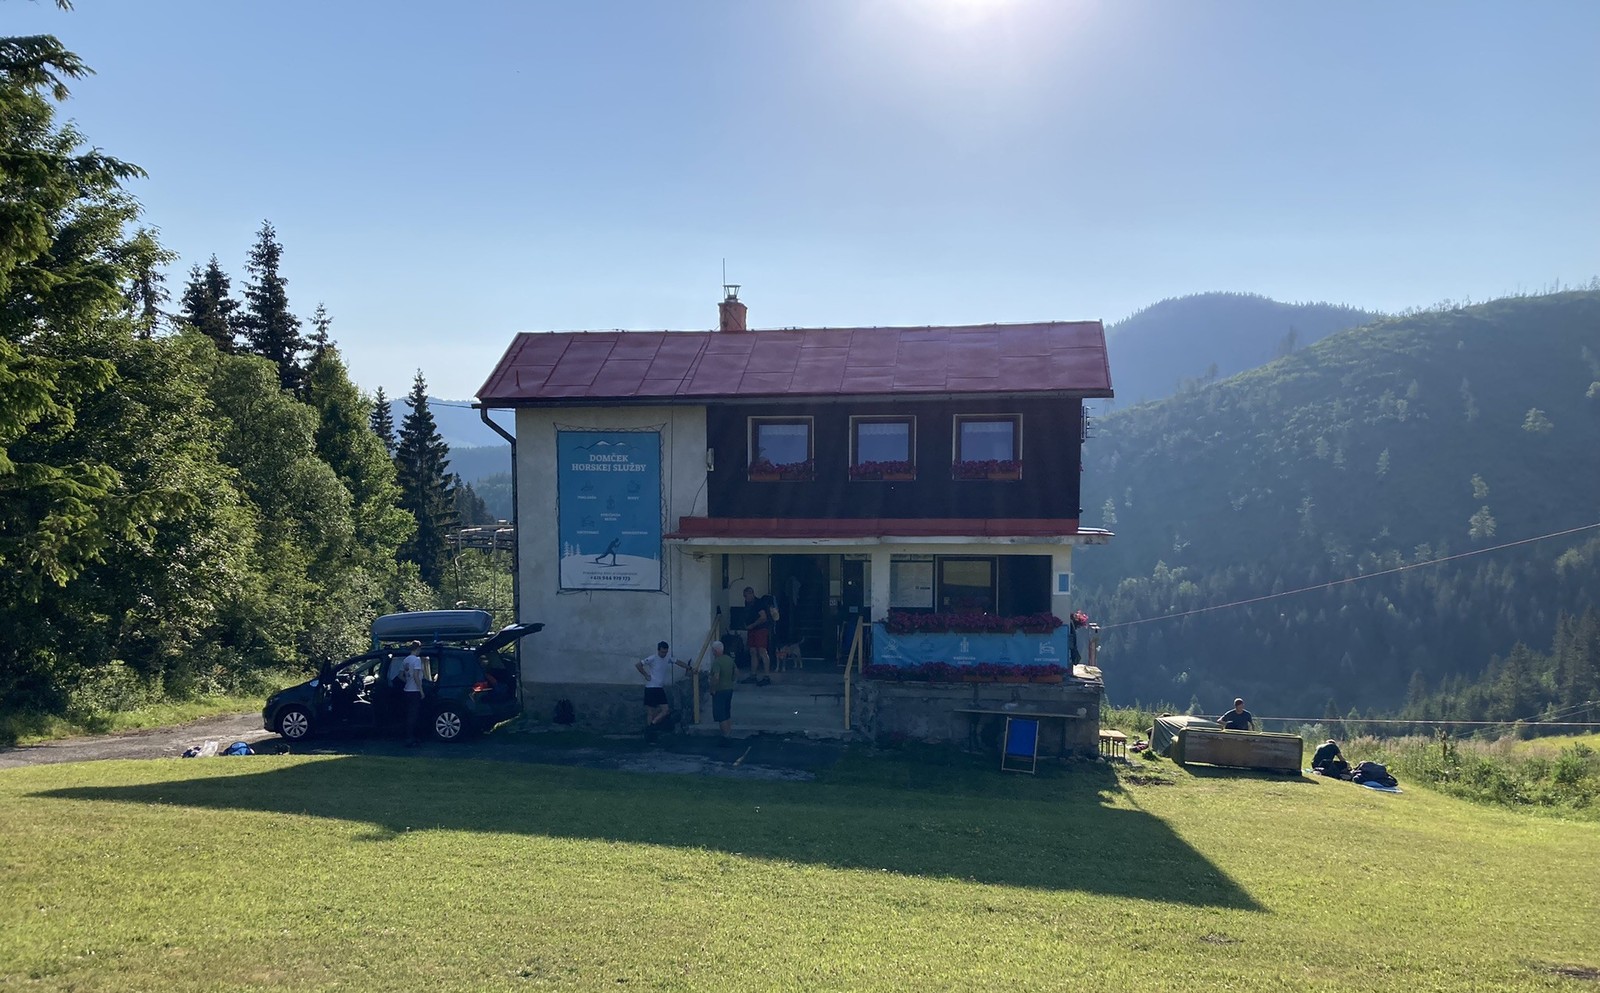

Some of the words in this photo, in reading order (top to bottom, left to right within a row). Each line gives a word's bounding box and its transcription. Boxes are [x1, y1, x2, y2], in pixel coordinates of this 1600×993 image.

[589, 452, 629, 462] DOMČEK
[571, 463, 611, 472] HORSKEJ
[612, 462, 647, 472] SLUŽBY
